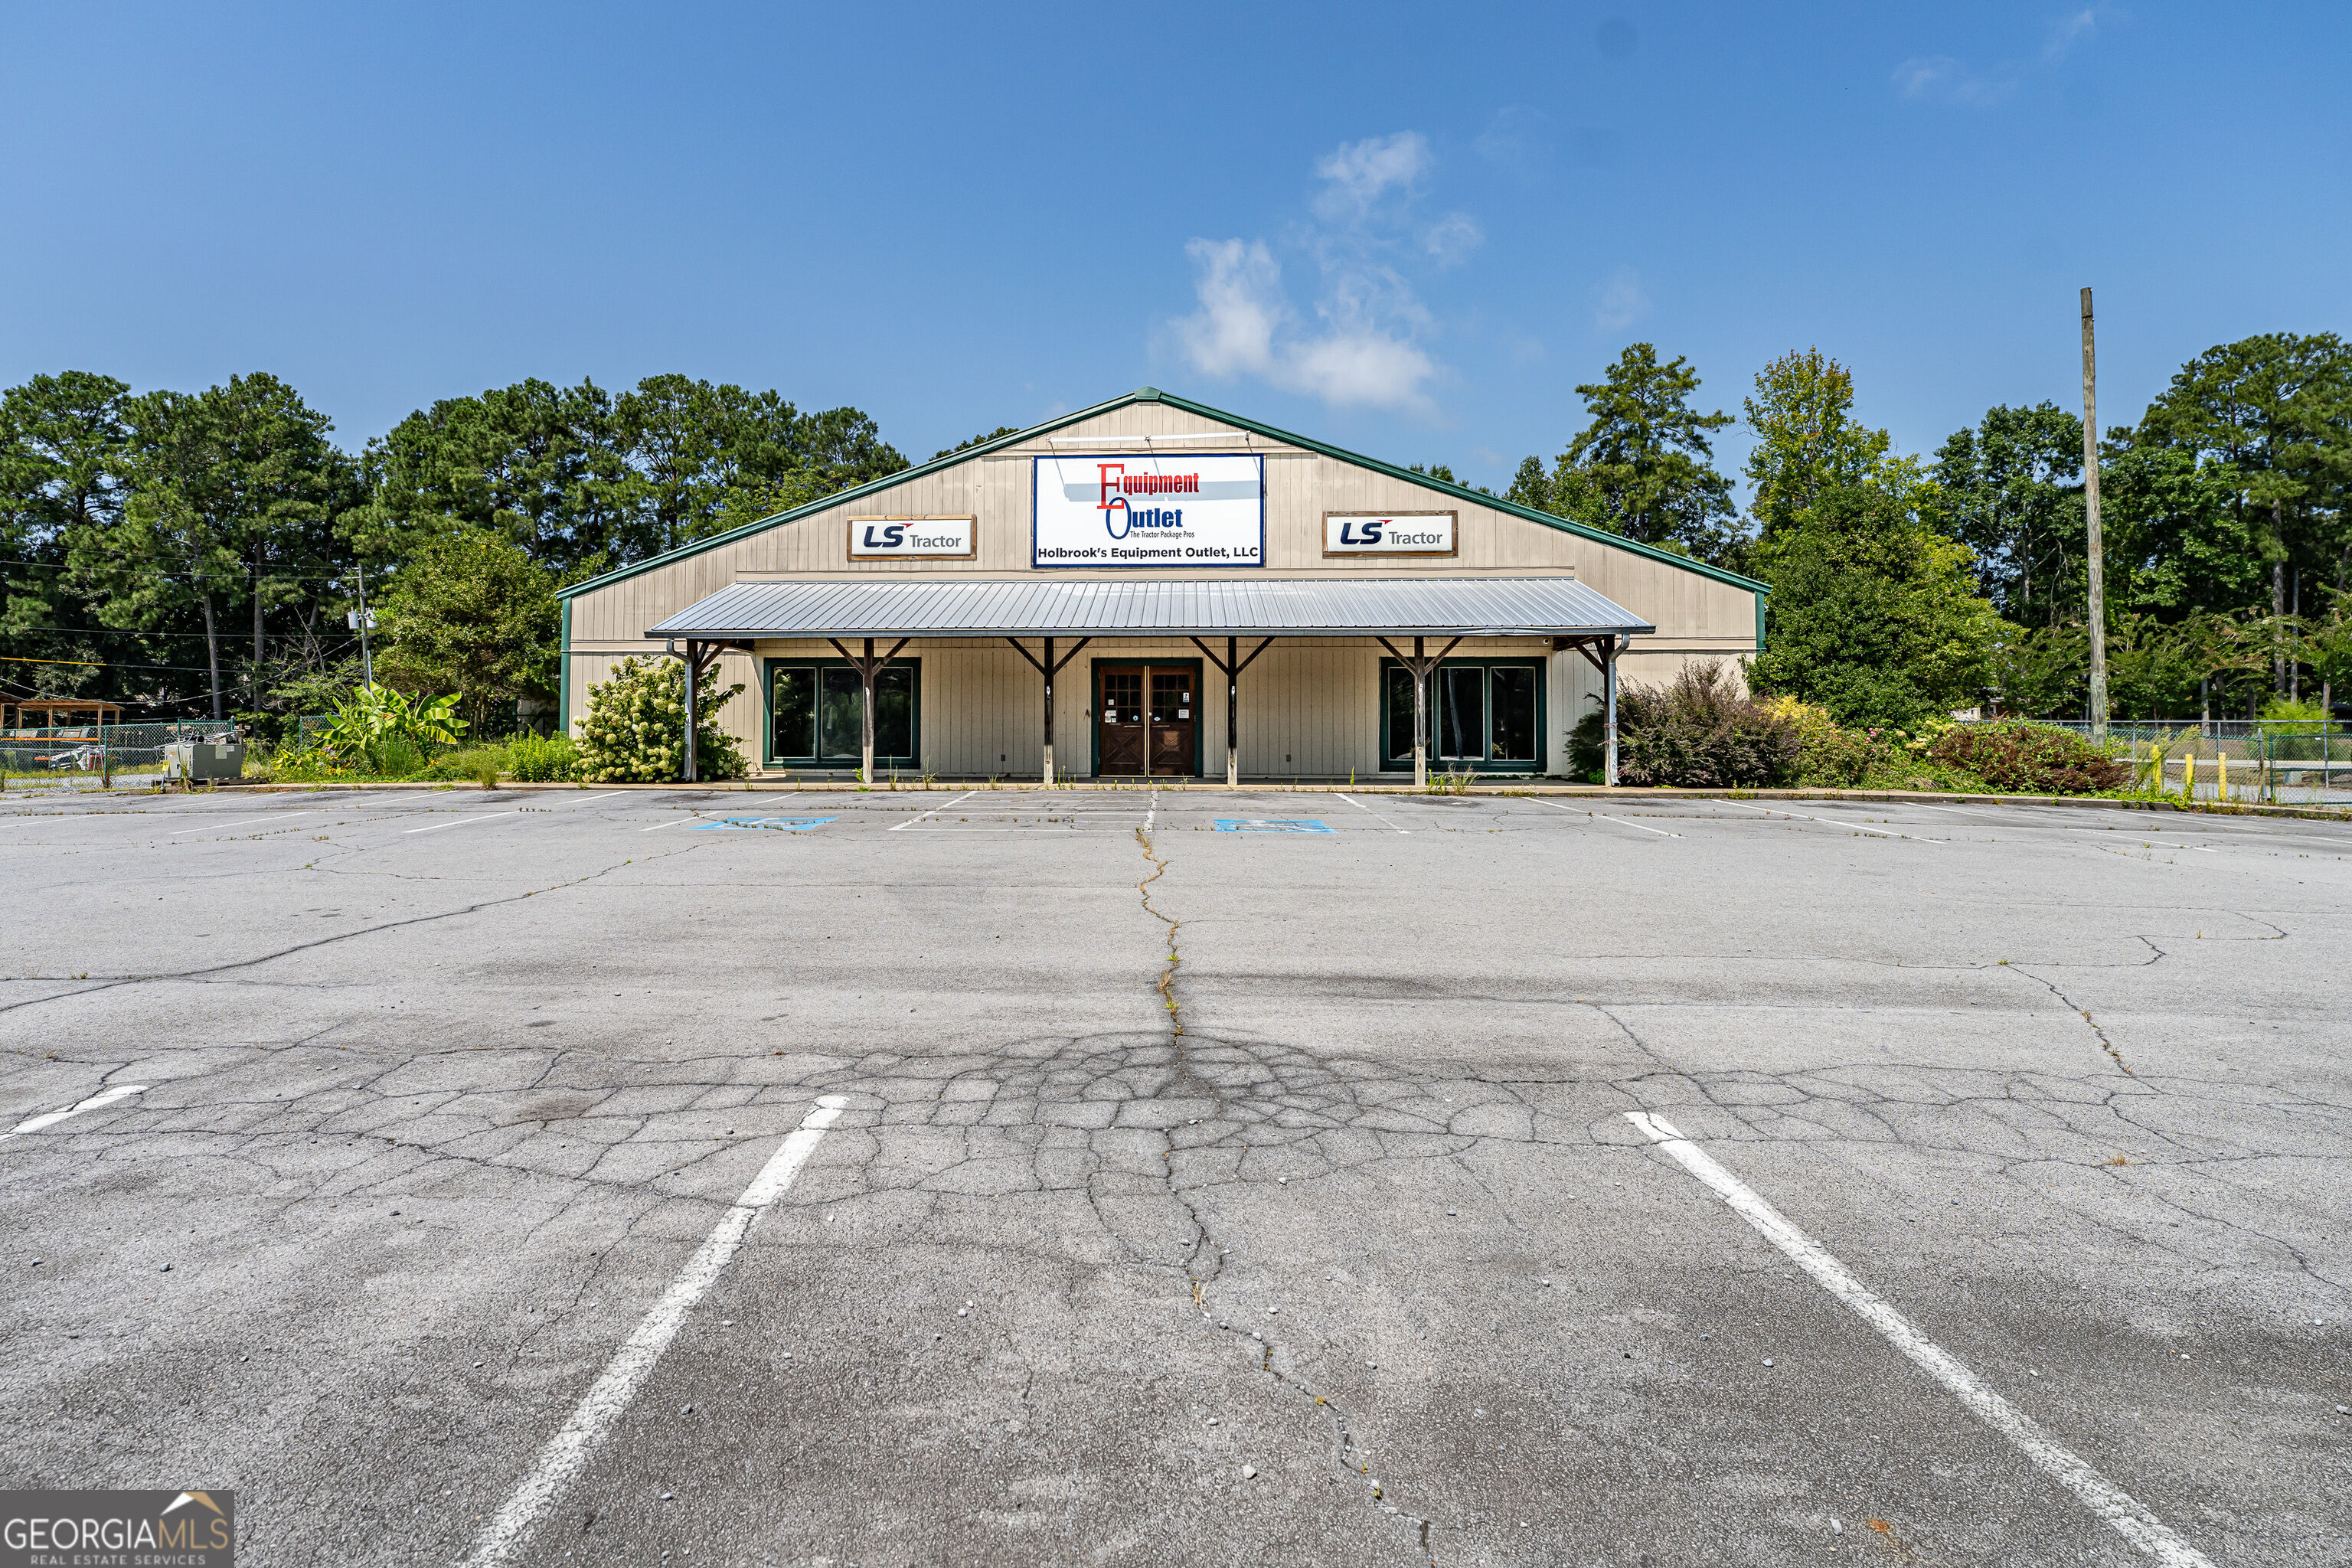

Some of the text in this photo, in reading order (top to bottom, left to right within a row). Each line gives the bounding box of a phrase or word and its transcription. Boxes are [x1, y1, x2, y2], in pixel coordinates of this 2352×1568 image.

[1097, 463, 1200, 510] Equipment
[1106, 497, 1183, 540] Outlet
[864, 526, 962, 547] LS Tractor
[1160, 531, 1182, 539] Package
[1341, 522, 1442, 544] LS Tractor
[1038, 547, 1259, 559] Holbrook's Equipment Outlet, LLC
